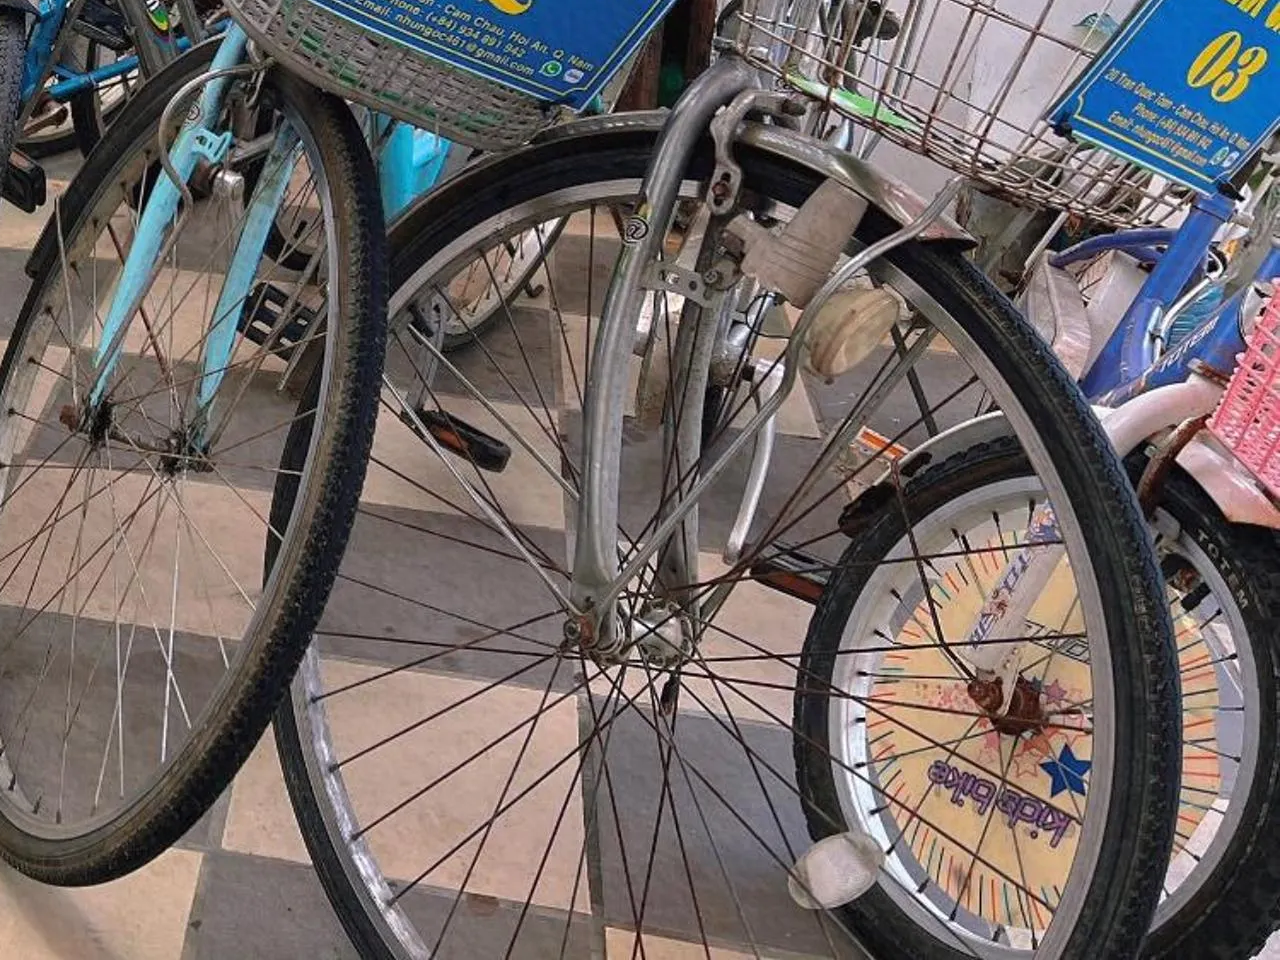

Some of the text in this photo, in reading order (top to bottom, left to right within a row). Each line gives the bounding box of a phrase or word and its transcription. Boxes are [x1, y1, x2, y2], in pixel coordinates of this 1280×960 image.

[444, 4, 471, 21] Cam
[509, 31, 531, 46] Hoi
[568, 55, 595, 72] Nam
[1187, 31, 1268, 103] 03
[927, 759, 997, 816] bike
